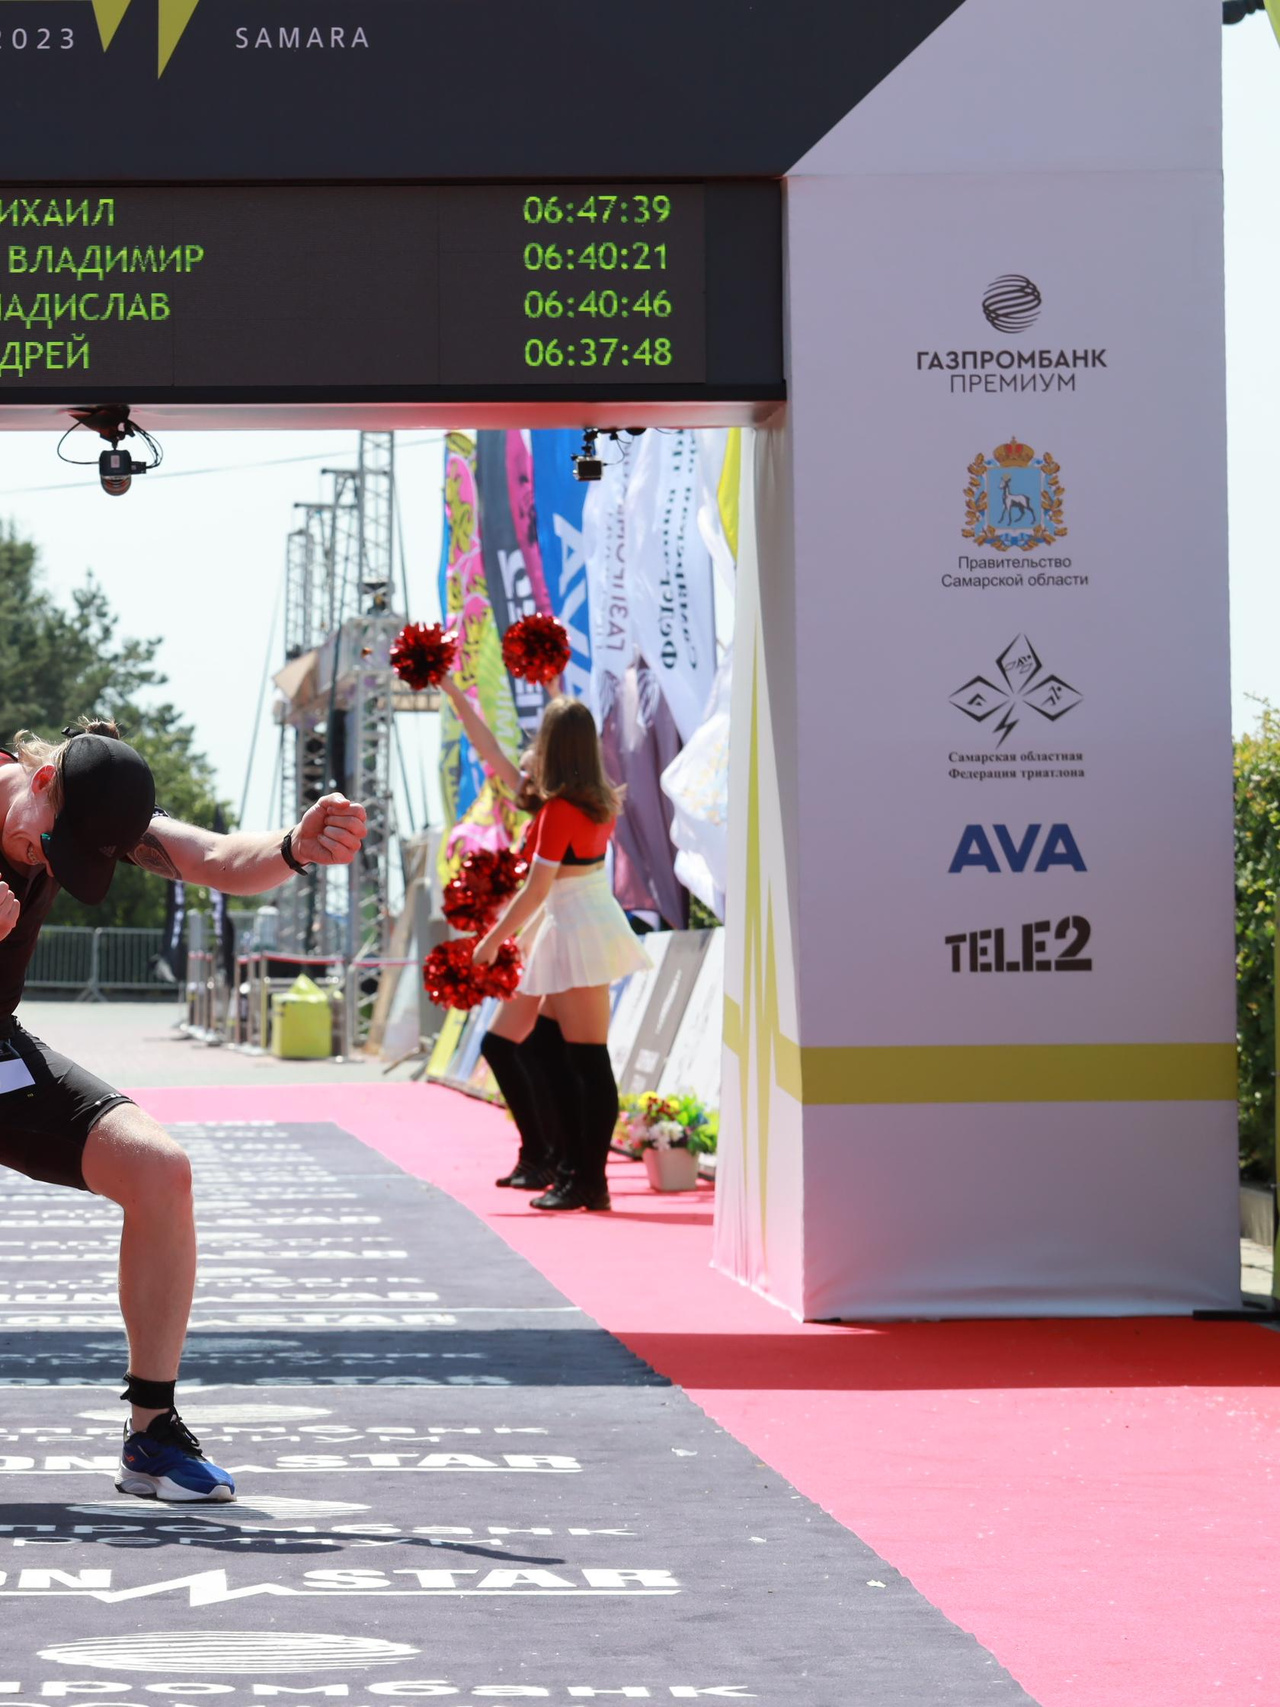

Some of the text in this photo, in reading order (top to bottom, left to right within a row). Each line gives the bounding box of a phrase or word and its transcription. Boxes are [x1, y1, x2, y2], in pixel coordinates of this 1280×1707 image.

[235, 27, 369, 48] SAMARA
[523, 195, 671, 224] 06:47:39
[9, 244, 204, 280] ВЛАДИМИР
[523, 242, 667, 270] 06:40:21
[524, 290, 672, 318] 06:40:46
[524, 338, 672, 366] 06:37:48
[917, 349, 1107, 370] ГАЗПРОМБАНК
[951, 373, 1076, 393] ПРЕМИУМ
[958, 556, 1072, 571] Правительство
[941, 573, 1089, 589] Самарской области
[948, 751, 1083, 765] Самарская областная
[948, 768, 1085, 781] Федерация триатлона
[948, 823, 1088, 873] AVA
[945, 915, 1092, 973] TELE2
[277, 1454, 582, 1468] STAR
[302, 1569, 680, 1589] STAR
